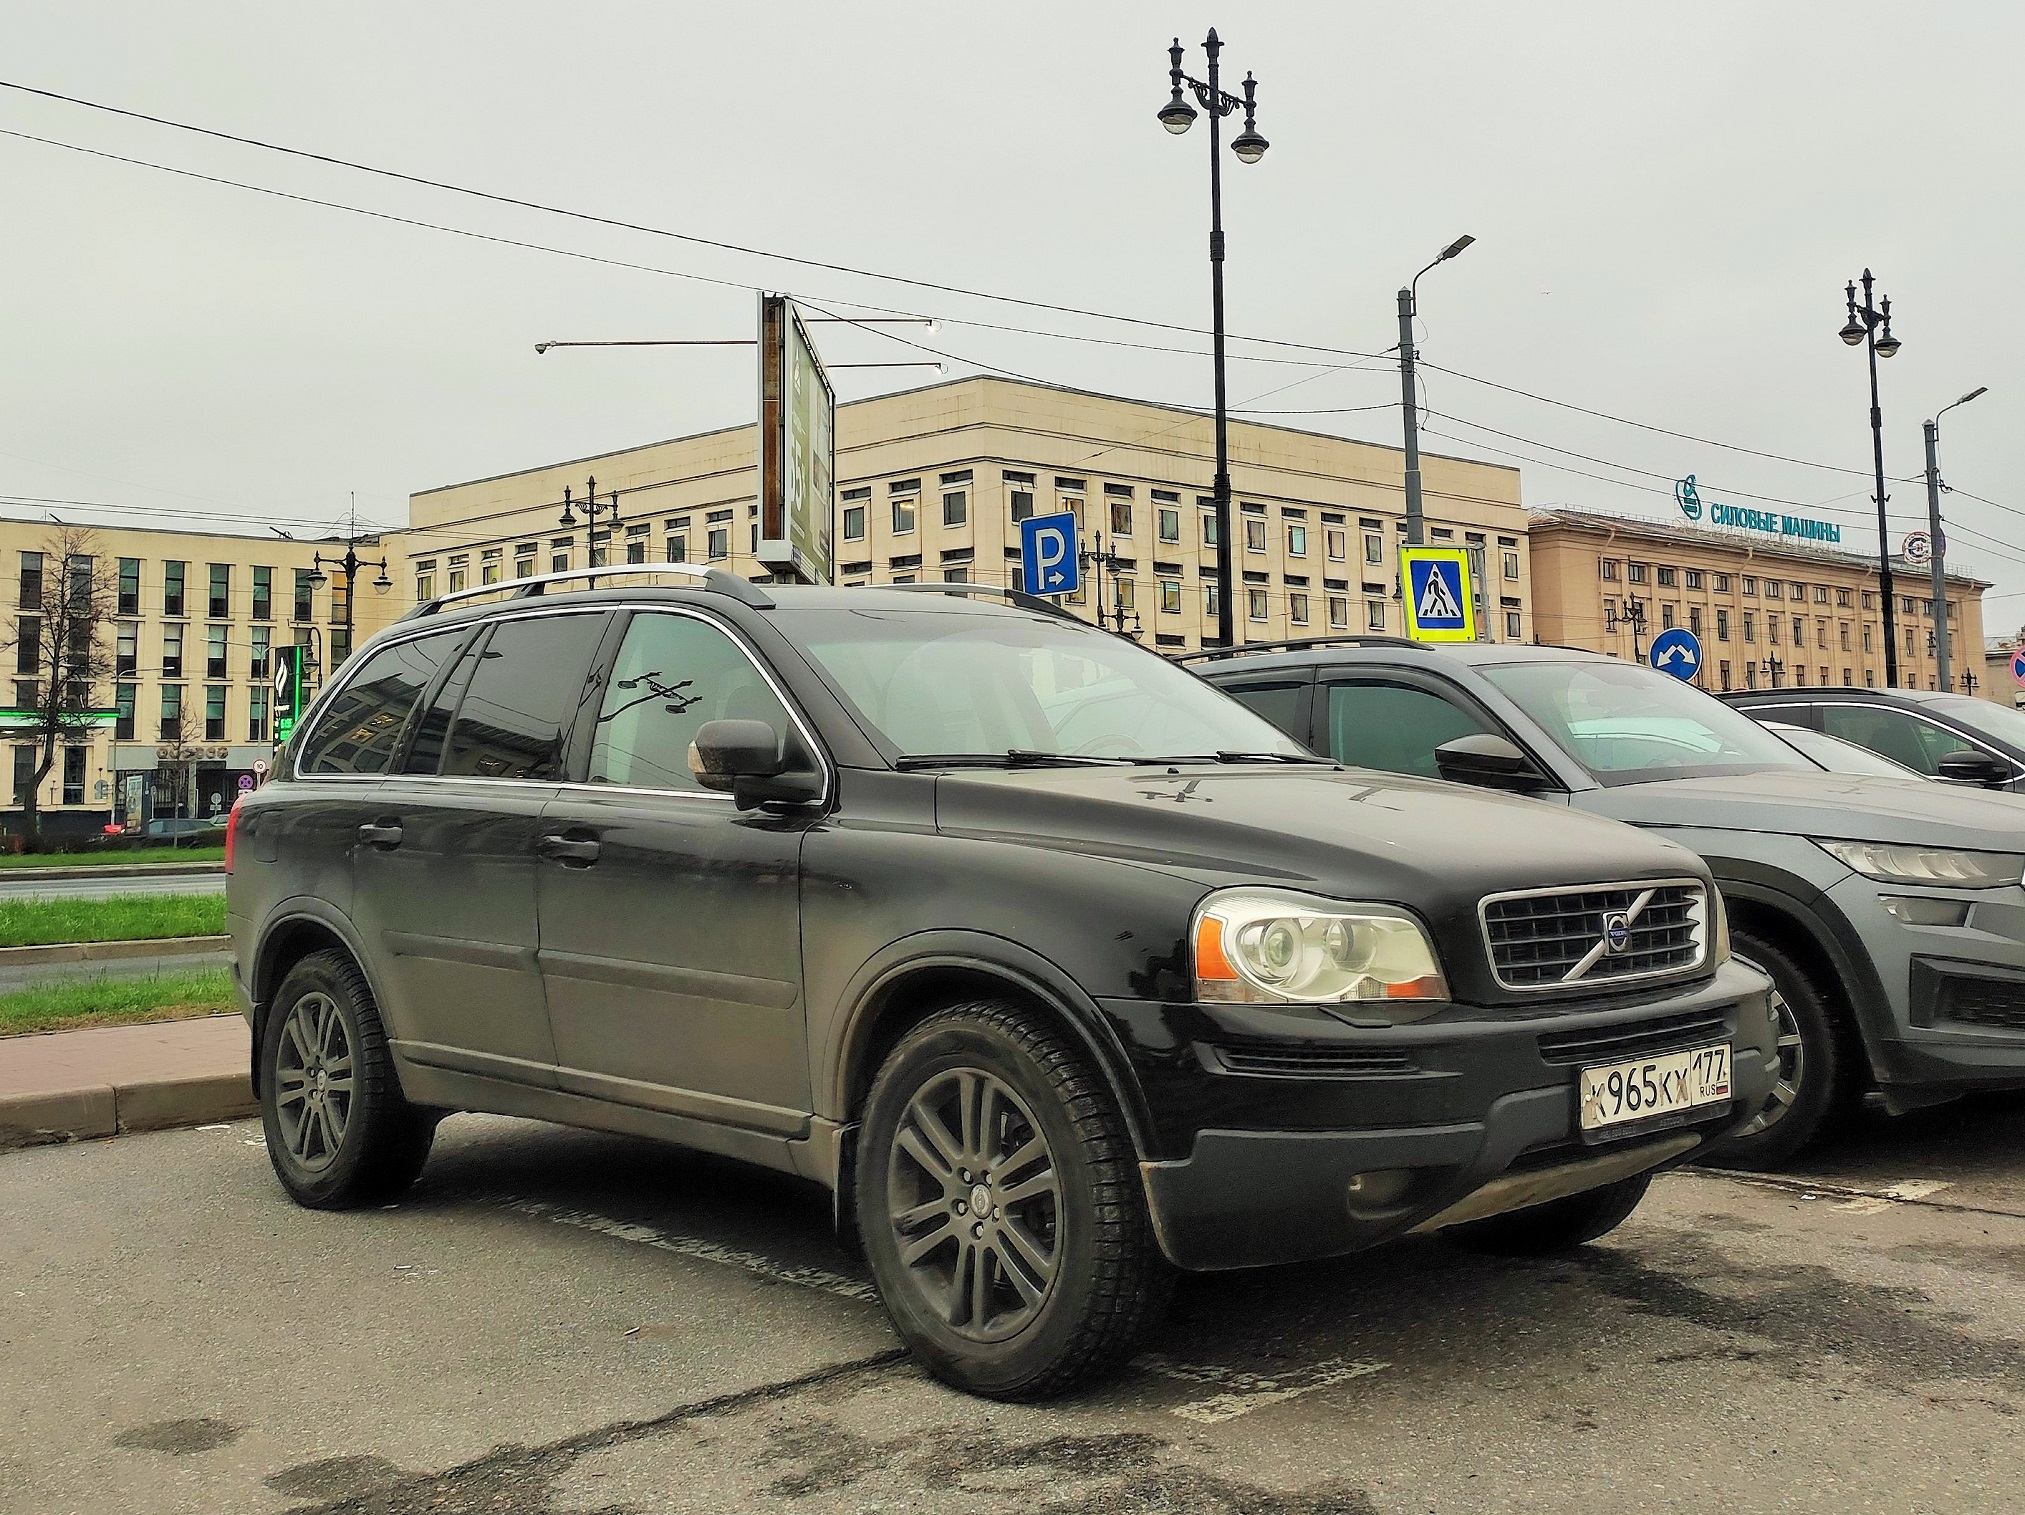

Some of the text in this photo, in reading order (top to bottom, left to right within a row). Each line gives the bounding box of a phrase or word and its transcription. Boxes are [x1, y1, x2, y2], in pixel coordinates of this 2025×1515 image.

[1710, 503, 1840, 543] СИЛОВЫЕ МАШИНЫ
[1035, 528, 1065, 590] P
[1692, 1048, 1725, 1085] 177
[1699, 1083, 1716, 1098] RUS
